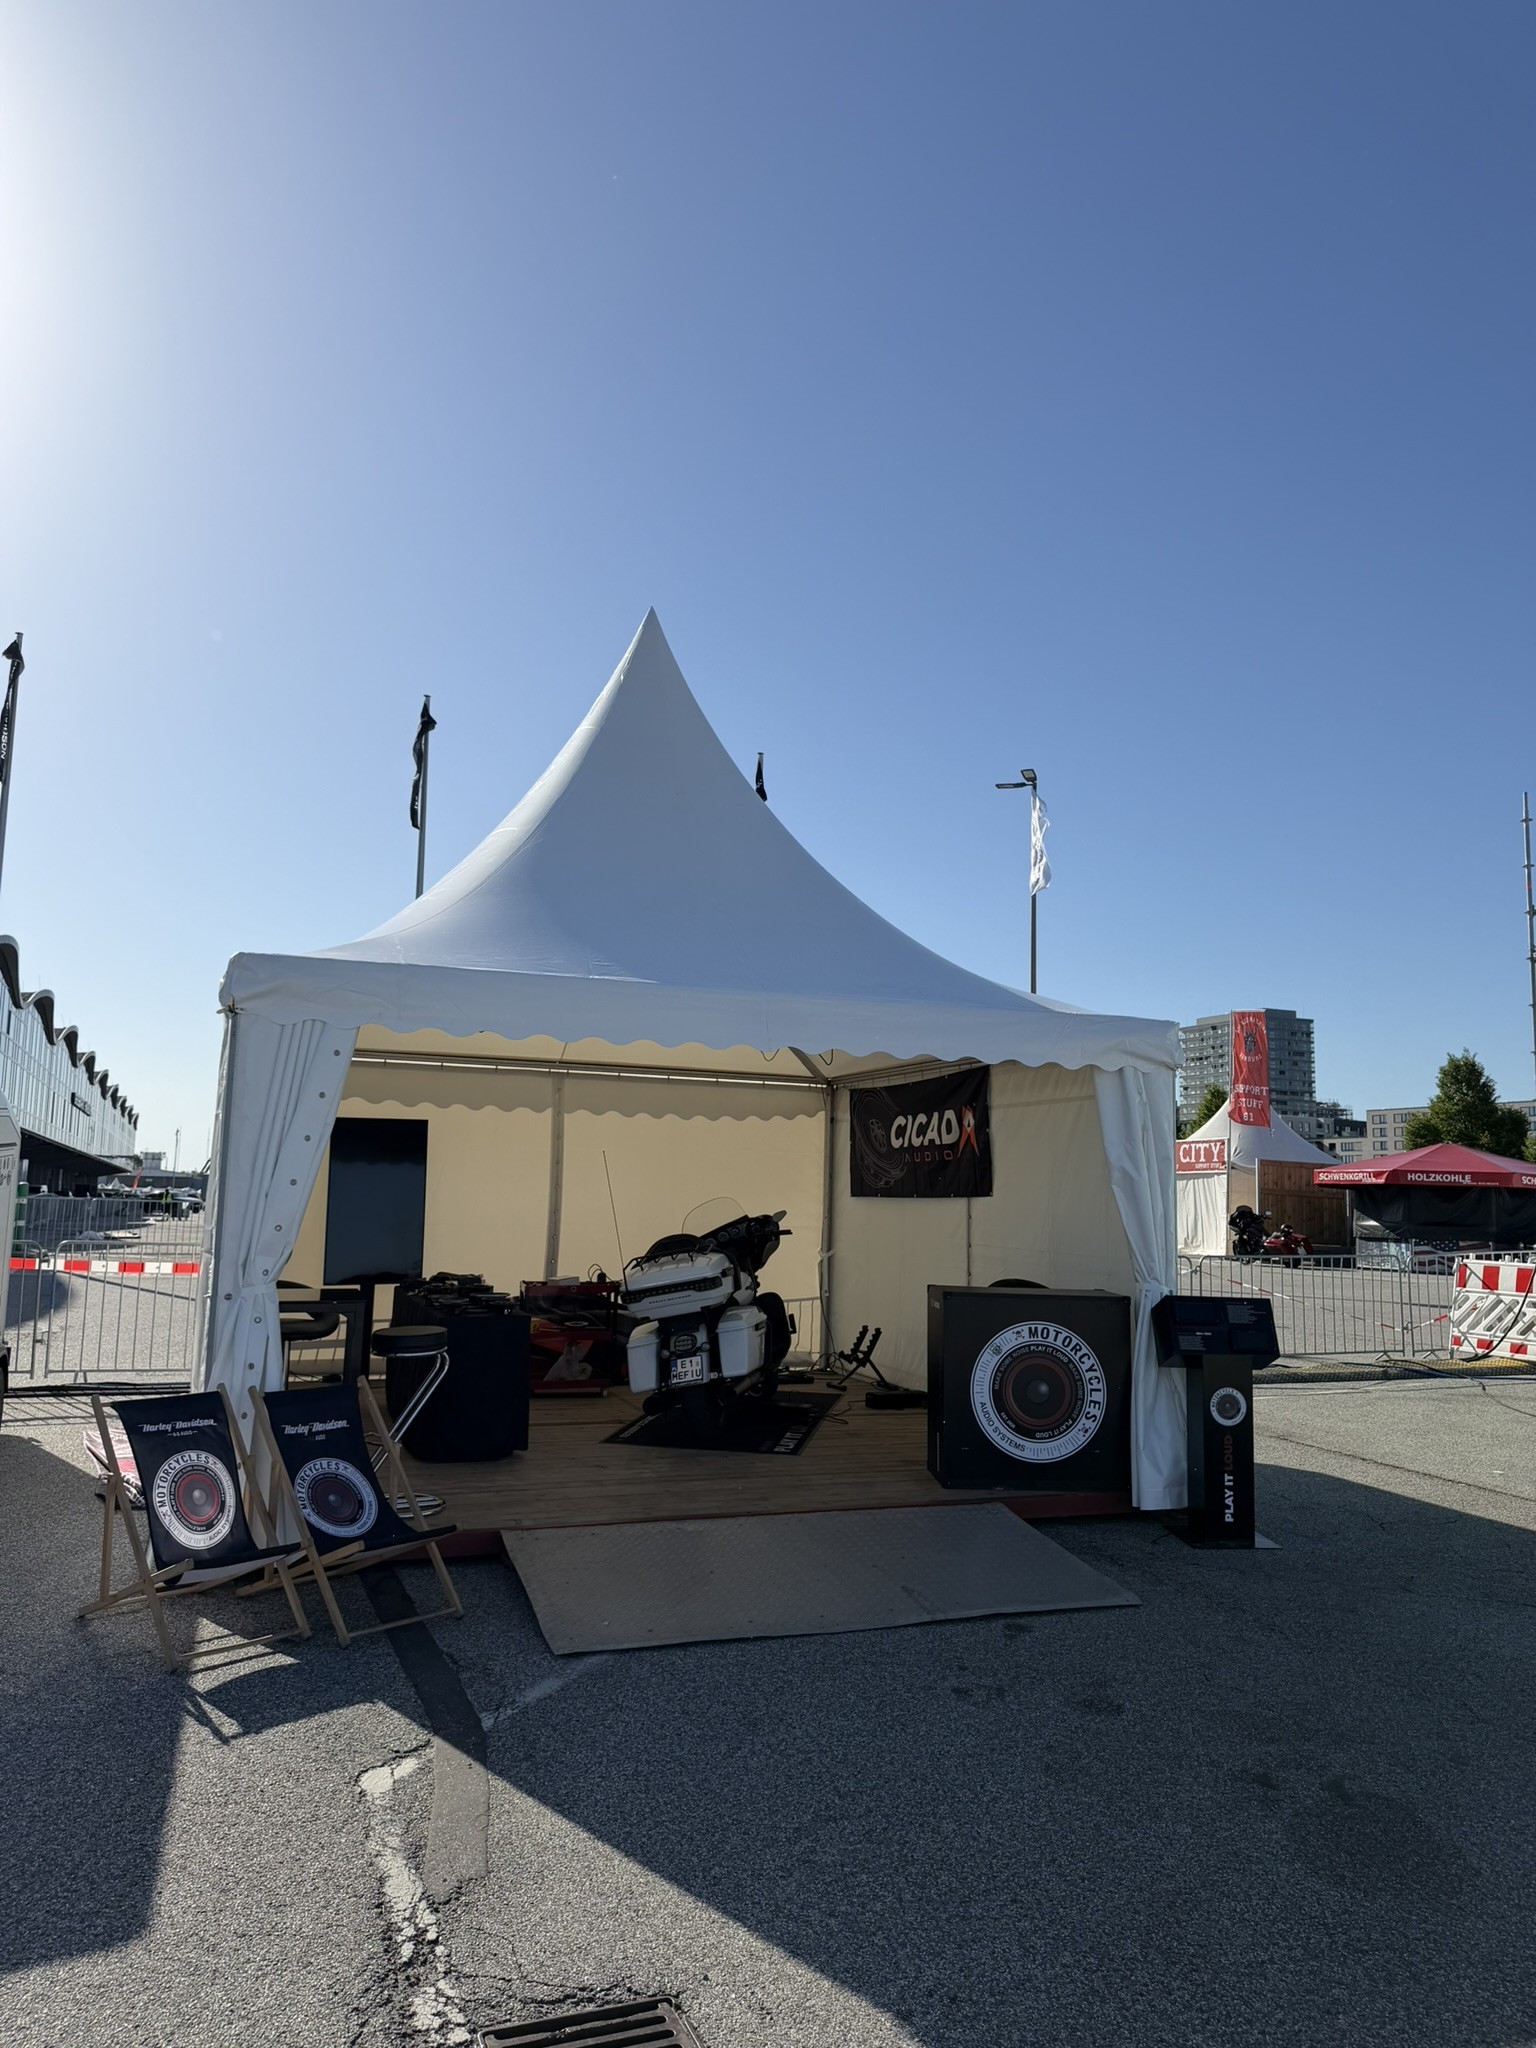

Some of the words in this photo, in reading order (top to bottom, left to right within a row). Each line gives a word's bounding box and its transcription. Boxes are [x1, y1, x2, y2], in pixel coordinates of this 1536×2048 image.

[890, 1106, 980, 1159] CICADA
[904, 1150, 954, 1162] AUDIO
[1179, 1142, 1222, 1163] CITY
[1318, 1172, 1374, 1181] SCHWENKGRILL
[1407, 1172, 1472, 1183] HOLZKOHLE
[1030, 1344, 1047, 1353] PLAY
[1046, 1346, 1055, 1354] IT
[1053, 1349, 1069, 1364] LOUD
[1028, 1326, 1102, 1425] MOTORCYCLES
[138, 1418, 218, 1433] Harley-Davidson
[281, 1419, 350, 1436] Harley-Davidson
[979, 1400, 996, 1428] AUDIO
[992, 1425, 1027, 1453] SYSTEMS
[1059, 1418, 1073, 1433] PLAY
[1035, 1431, 1054, 1439] LOUD
[1224, 1434, 1233, 1471] LOUD
[156, 1452, 211, 1510] MOTORCYCLES
[298, 1460, 342, 1511] MOTORCYCLES
[1225, 1472, 1234, 1487] IT
[1225, 1489, 1234, 1523] PLAY
